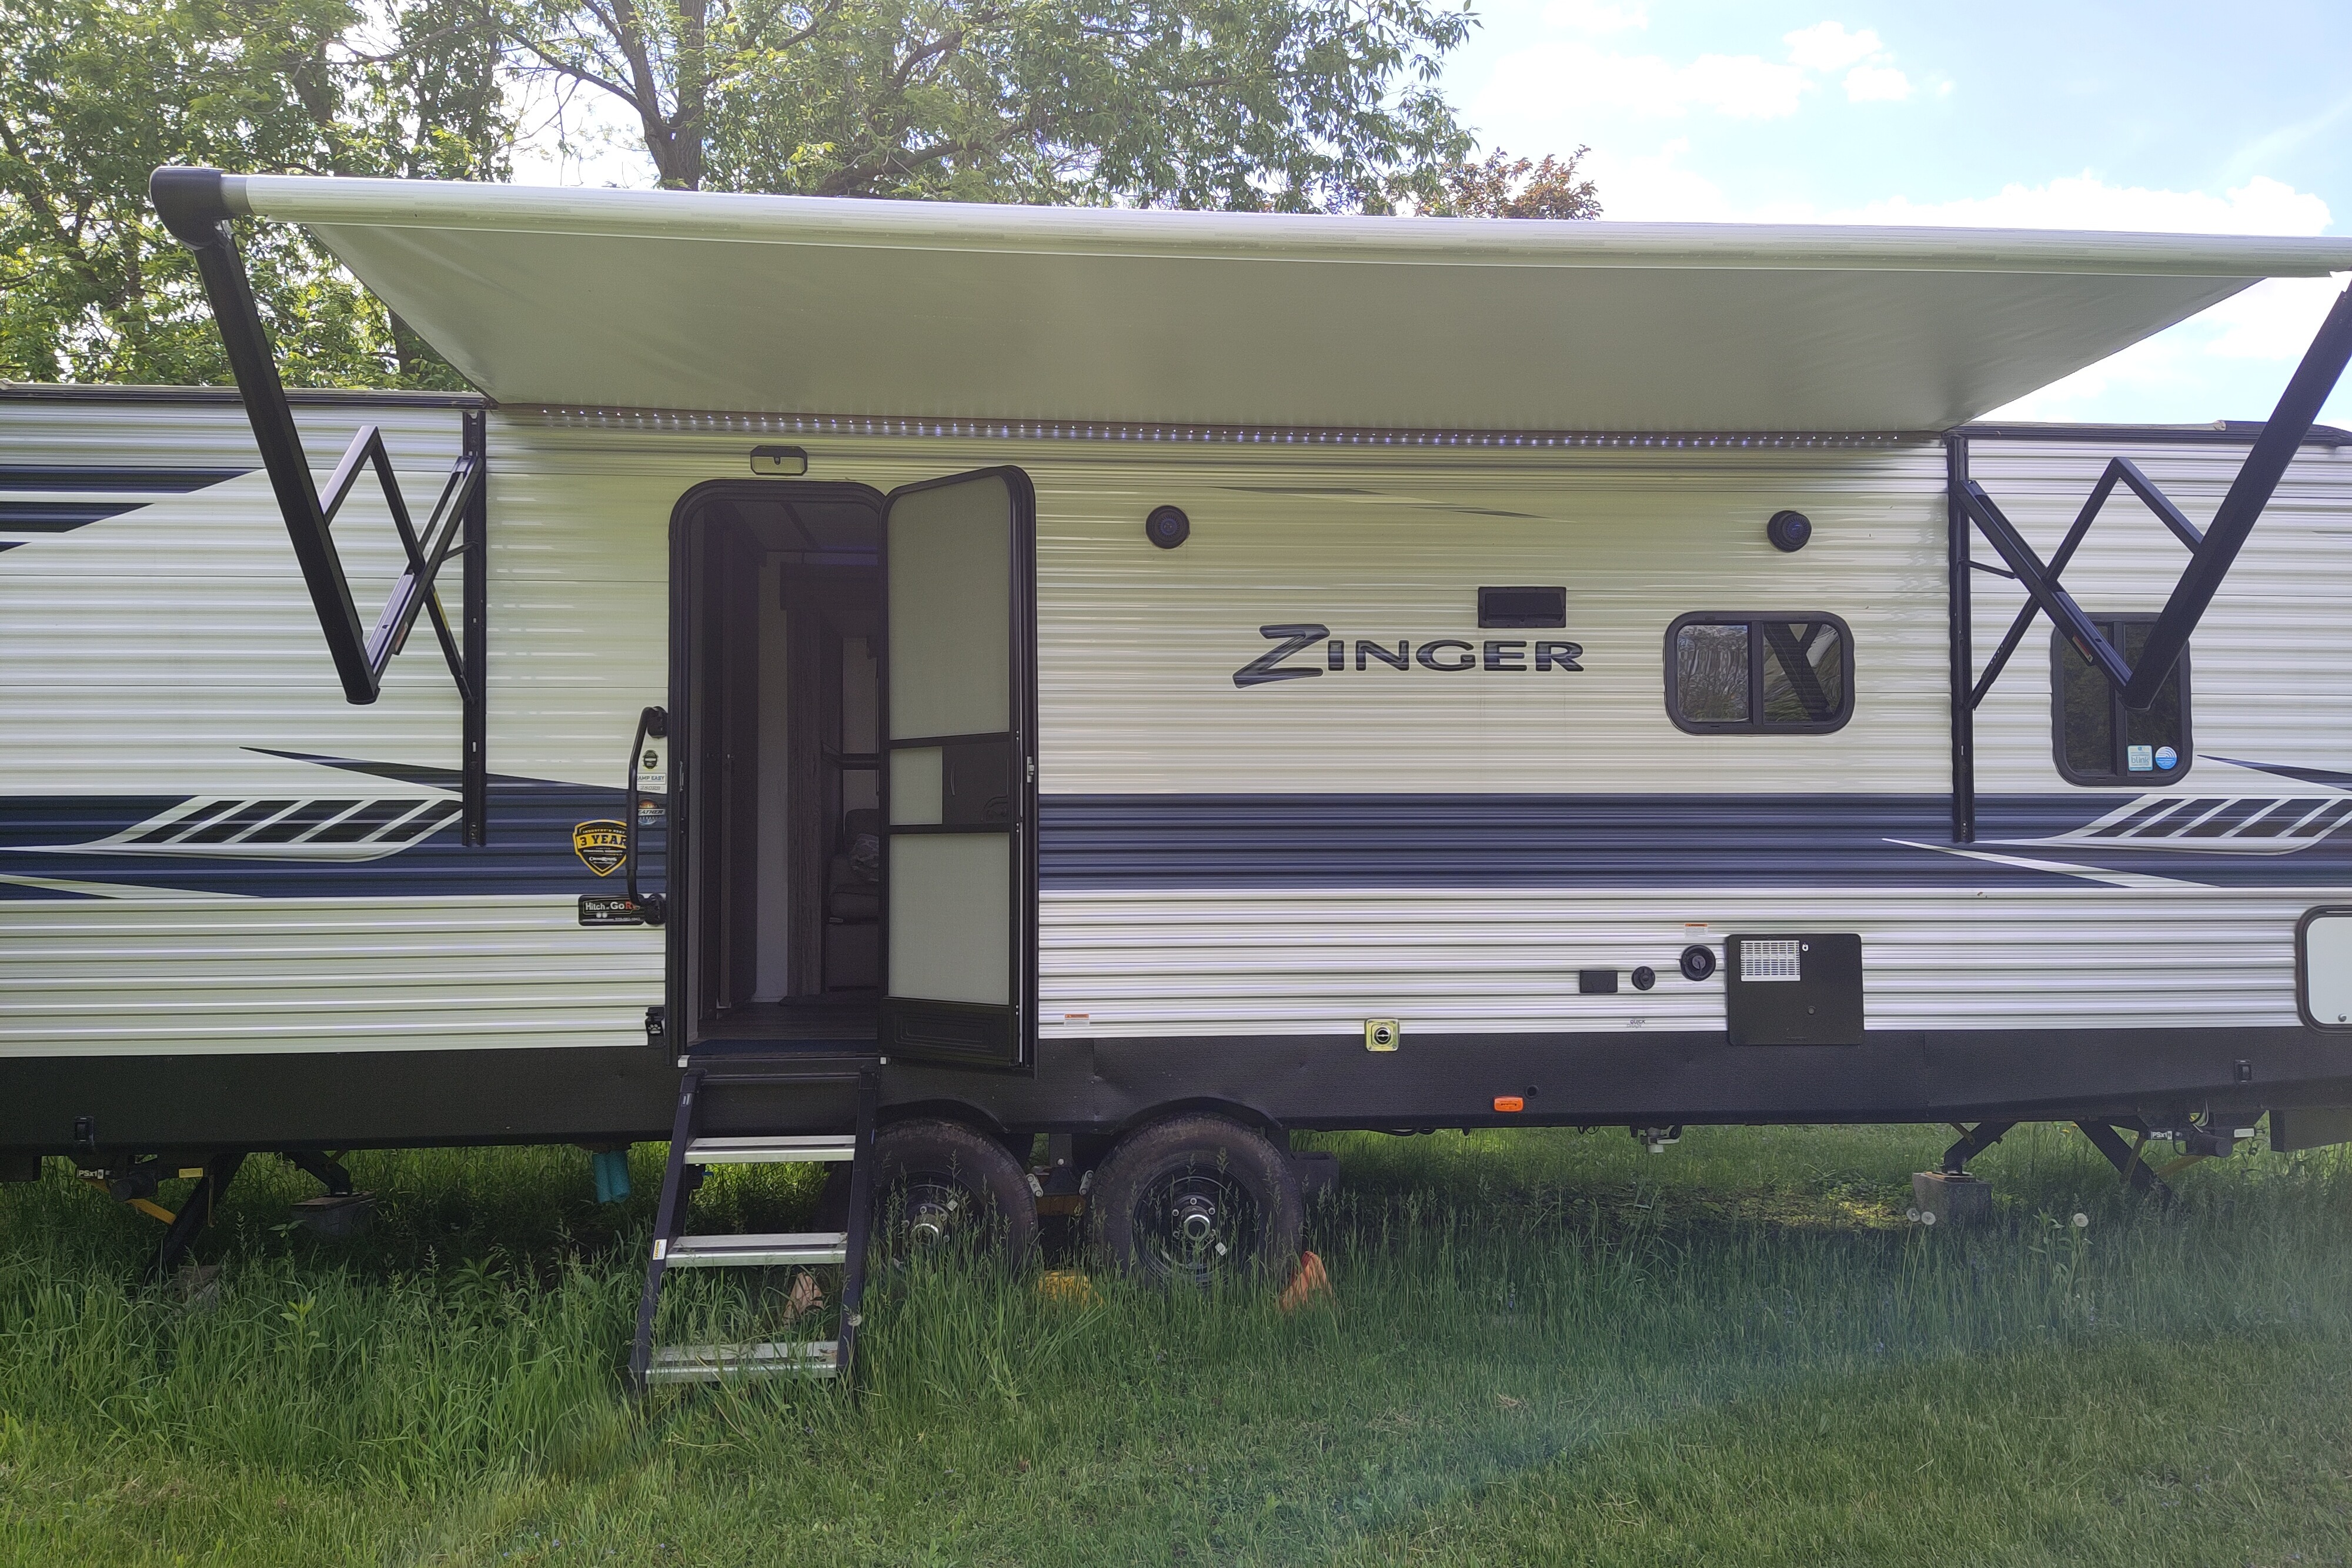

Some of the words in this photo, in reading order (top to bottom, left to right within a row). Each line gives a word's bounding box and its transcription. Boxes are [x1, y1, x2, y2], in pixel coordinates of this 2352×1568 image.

[1232, 624, 1584, 688] ZINGER
[579, 837, 587, 847] 3
[585, 902, 606, 910] Hitch
